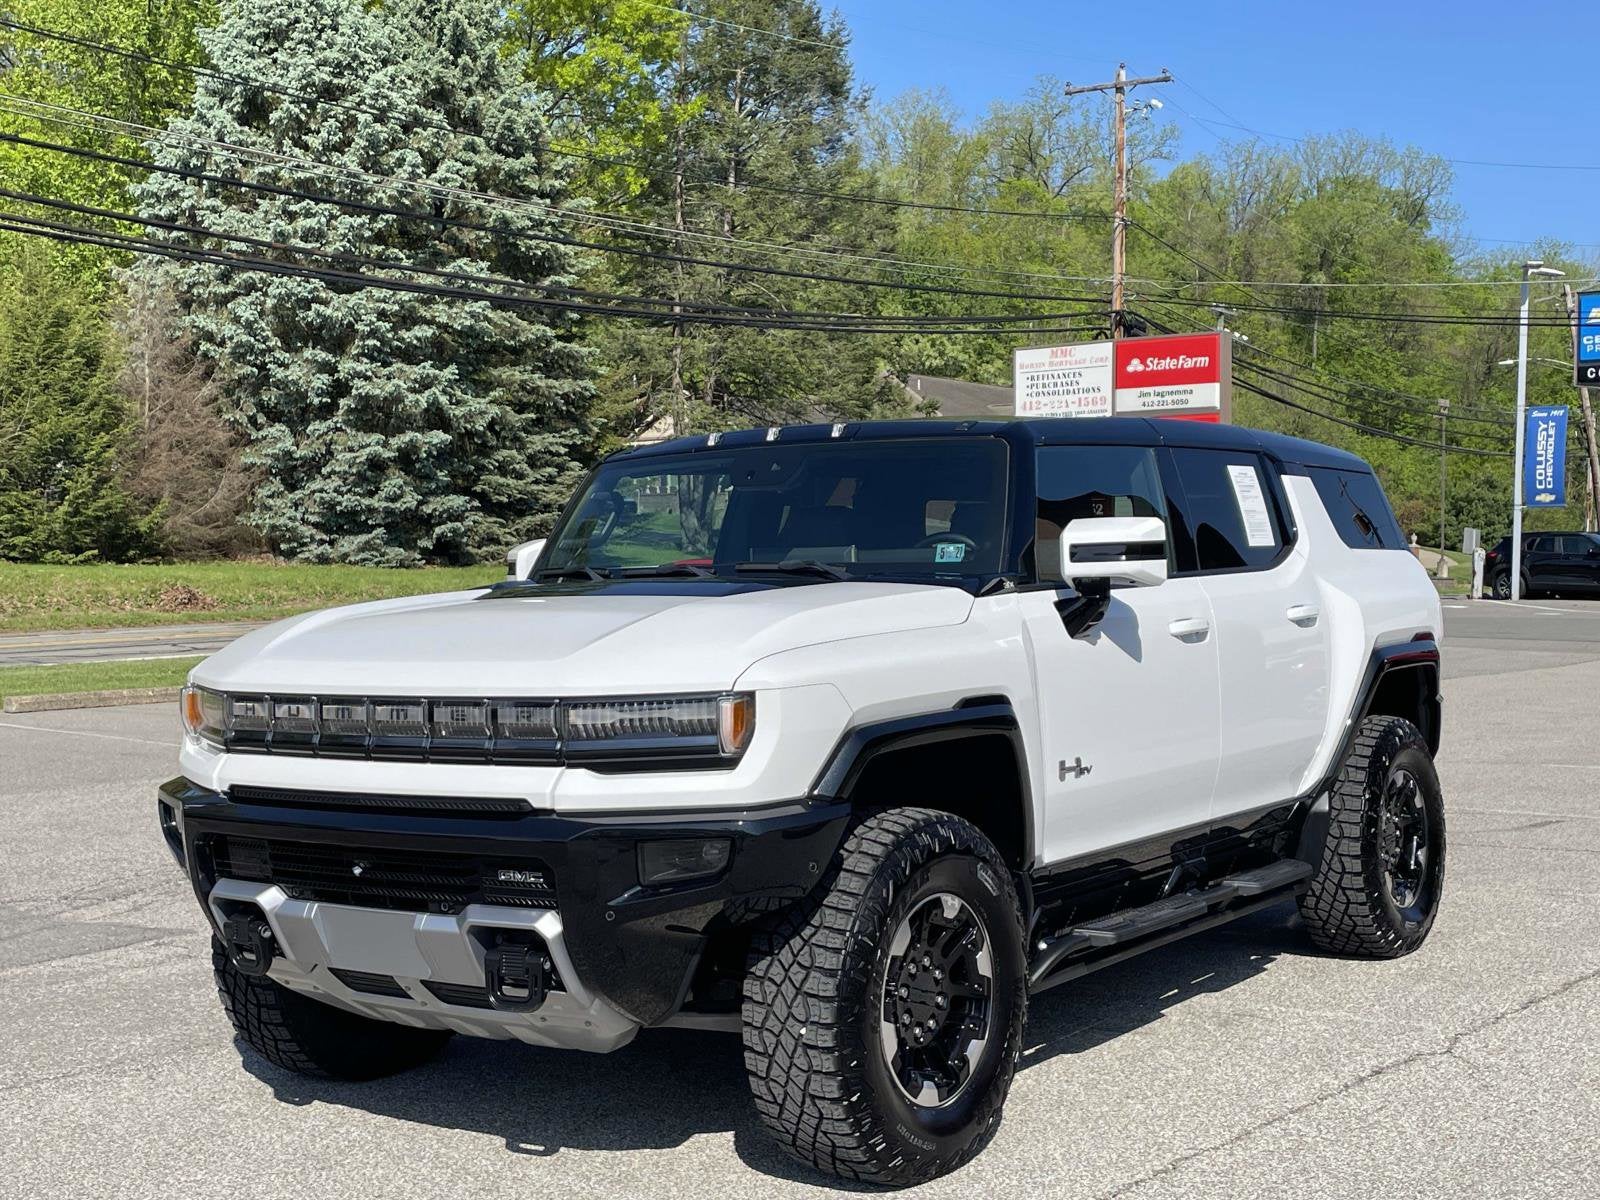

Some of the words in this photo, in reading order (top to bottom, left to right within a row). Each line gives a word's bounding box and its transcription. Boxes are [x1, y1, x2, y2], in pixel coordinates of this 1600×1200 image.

[1048, 358, 1087, 368] MORTGAGE
[1030, 371, 1083, 382] REFINANCES
[1030, 380, 1080, 390] PURCHASES
[1030, 386, 1102, 398] CONSOLIDATIONS
[1138, 390, 1151, 398] Jim
[1141, 398, 1189, 408] 412-221-5050
[1536, 420, 1548, 489] COLUSSY
[1546, 420, 1556, 489] CHEVROLET
[498, 869, 544, 883] GMC
